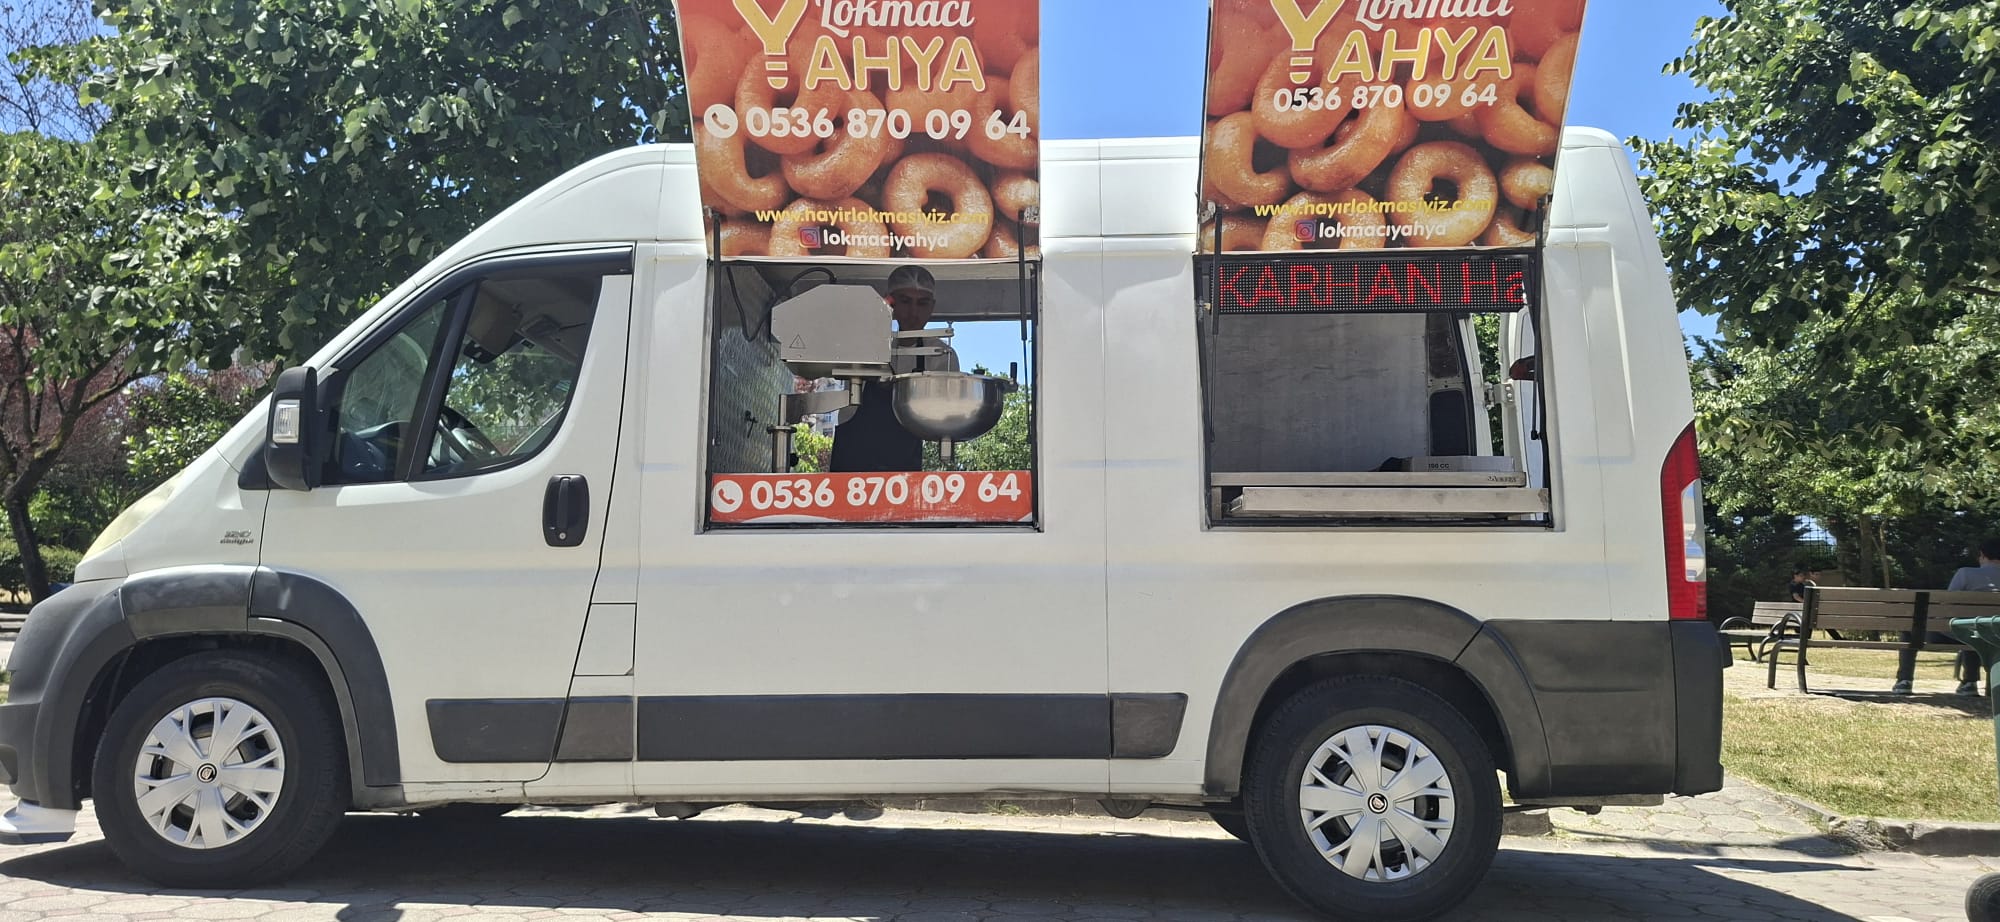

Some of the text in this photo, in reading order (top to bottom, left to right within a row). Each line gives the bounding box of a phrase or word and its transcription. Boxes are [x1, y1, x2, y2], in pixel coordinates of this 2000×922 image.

[1273, 83, 1498, 113] 0536 870 09 64
[745, 107, 1031, 140] 0536 870 09 64
[822, 228, 949, 251] lokmaciyahya
[1219, 263, 1442, 306] KARHAN
[750, 472, 1021, 510] 0536 870 09 64
